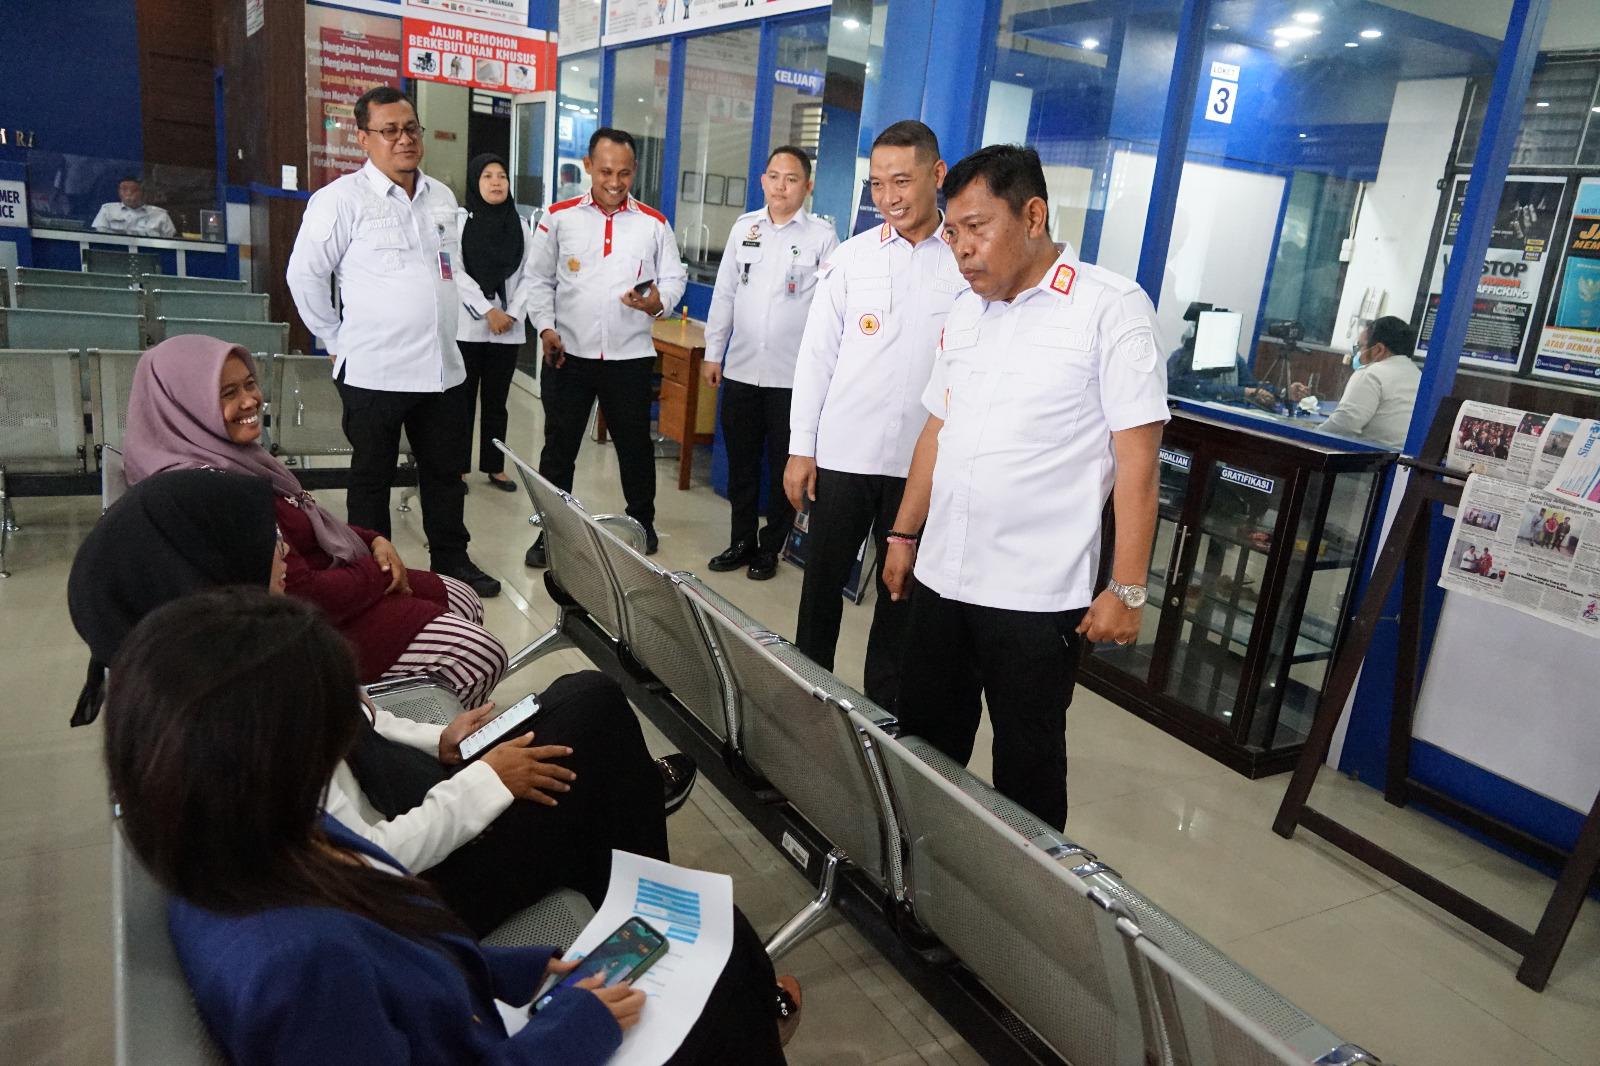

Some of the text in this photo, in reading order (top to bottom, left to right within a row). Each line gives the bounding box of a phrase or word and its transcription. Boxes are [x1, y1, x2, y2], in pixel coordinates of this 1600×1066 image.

[409, 34, 537, 65] BERKEBUTUHAN KHUSUS
[429, 25, 518, 50] JALUR PEMOHON
[1213, 87, 1230, 115] 3
[1577, 431, 1597, 458] Sinar
[1221, 469, 1270, 490] GRATIFIKASI
